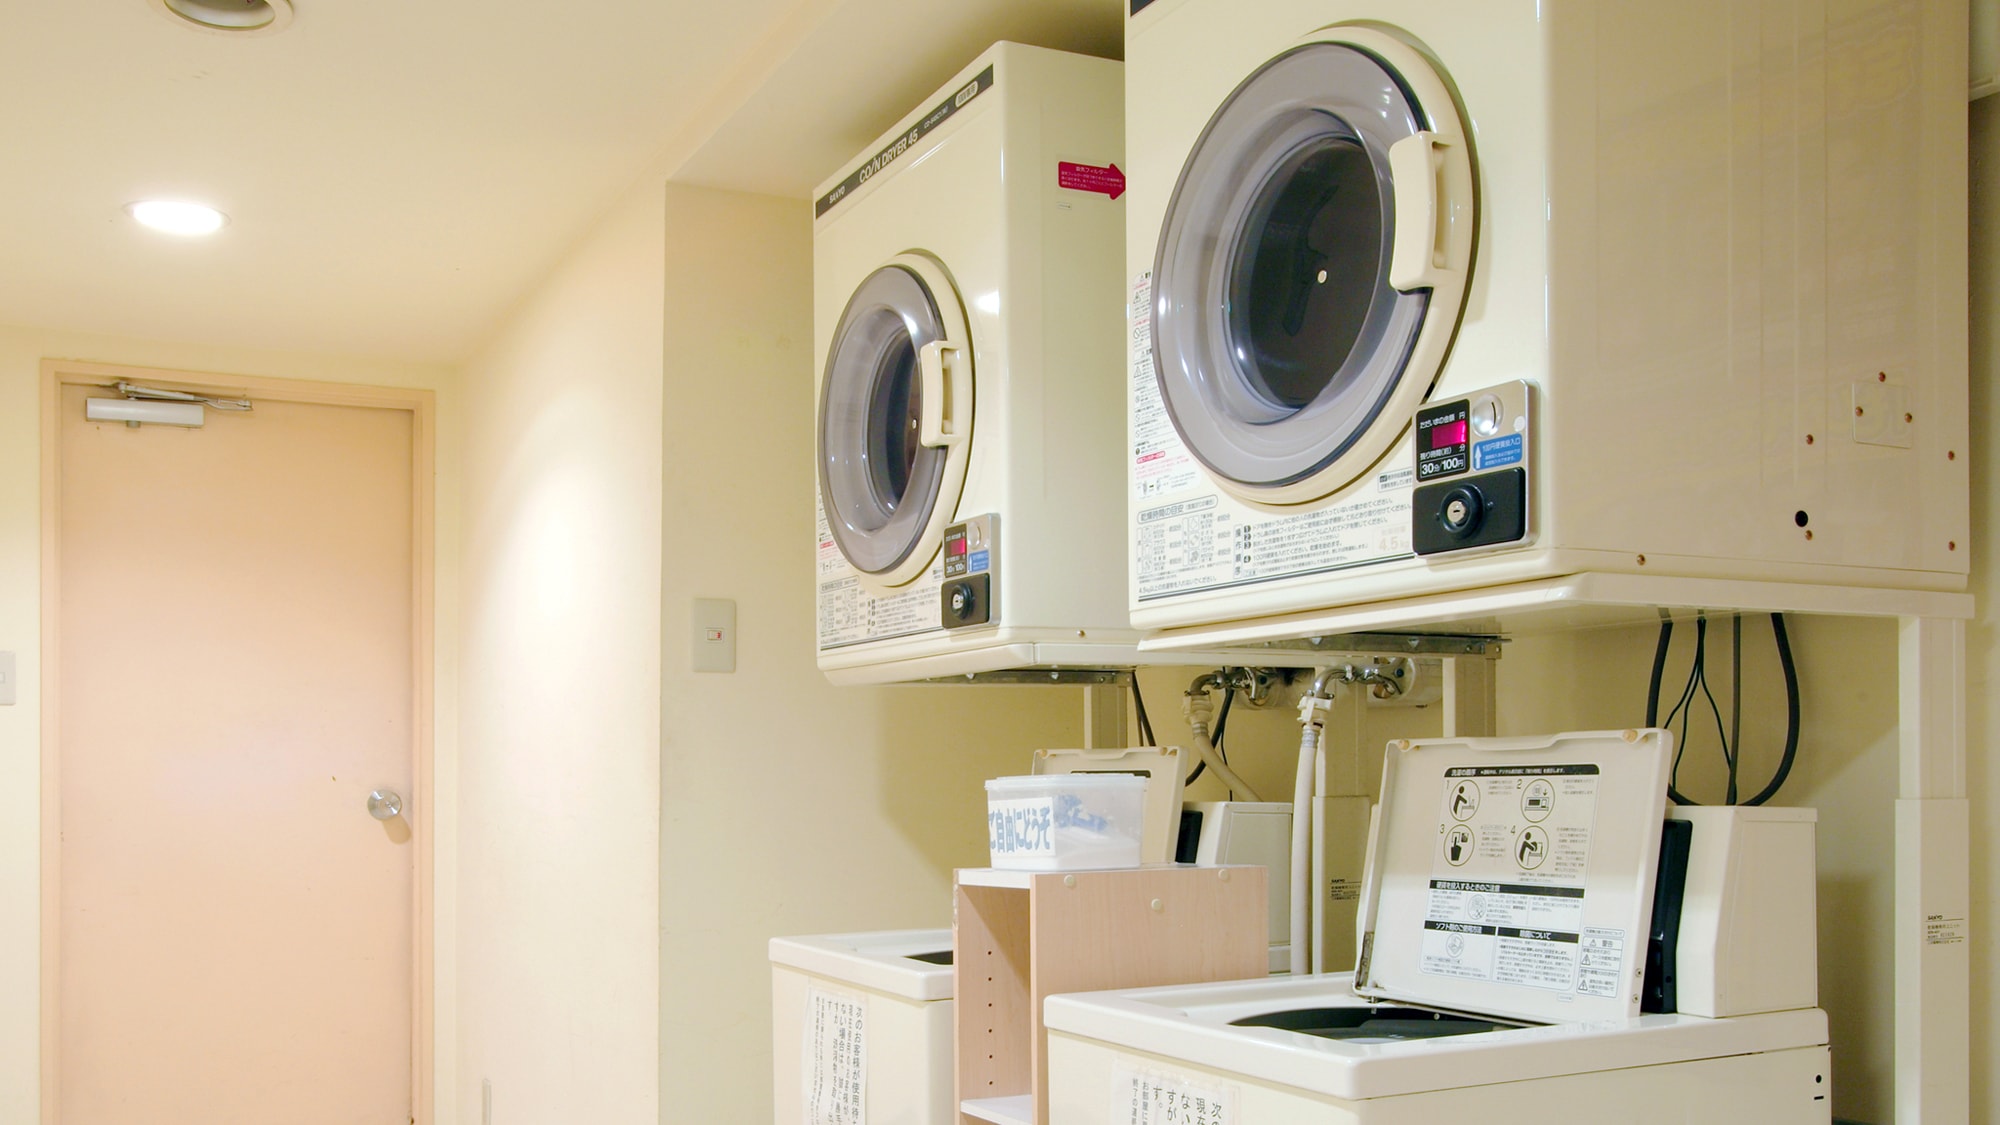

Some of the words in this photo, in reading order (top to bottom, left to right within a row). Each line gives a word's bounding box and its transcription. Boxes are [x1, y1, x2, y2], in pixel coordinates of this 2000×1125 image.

[881, 136, 907, 167] DRYER
[908, 128, 919, 146] 45
[829, 185, 846, 204] SANYO
[1517, 778, 1523, 789] 2
[1439, 823, 1445, 835] 3
[1510, 825, 1516, 834] 4
